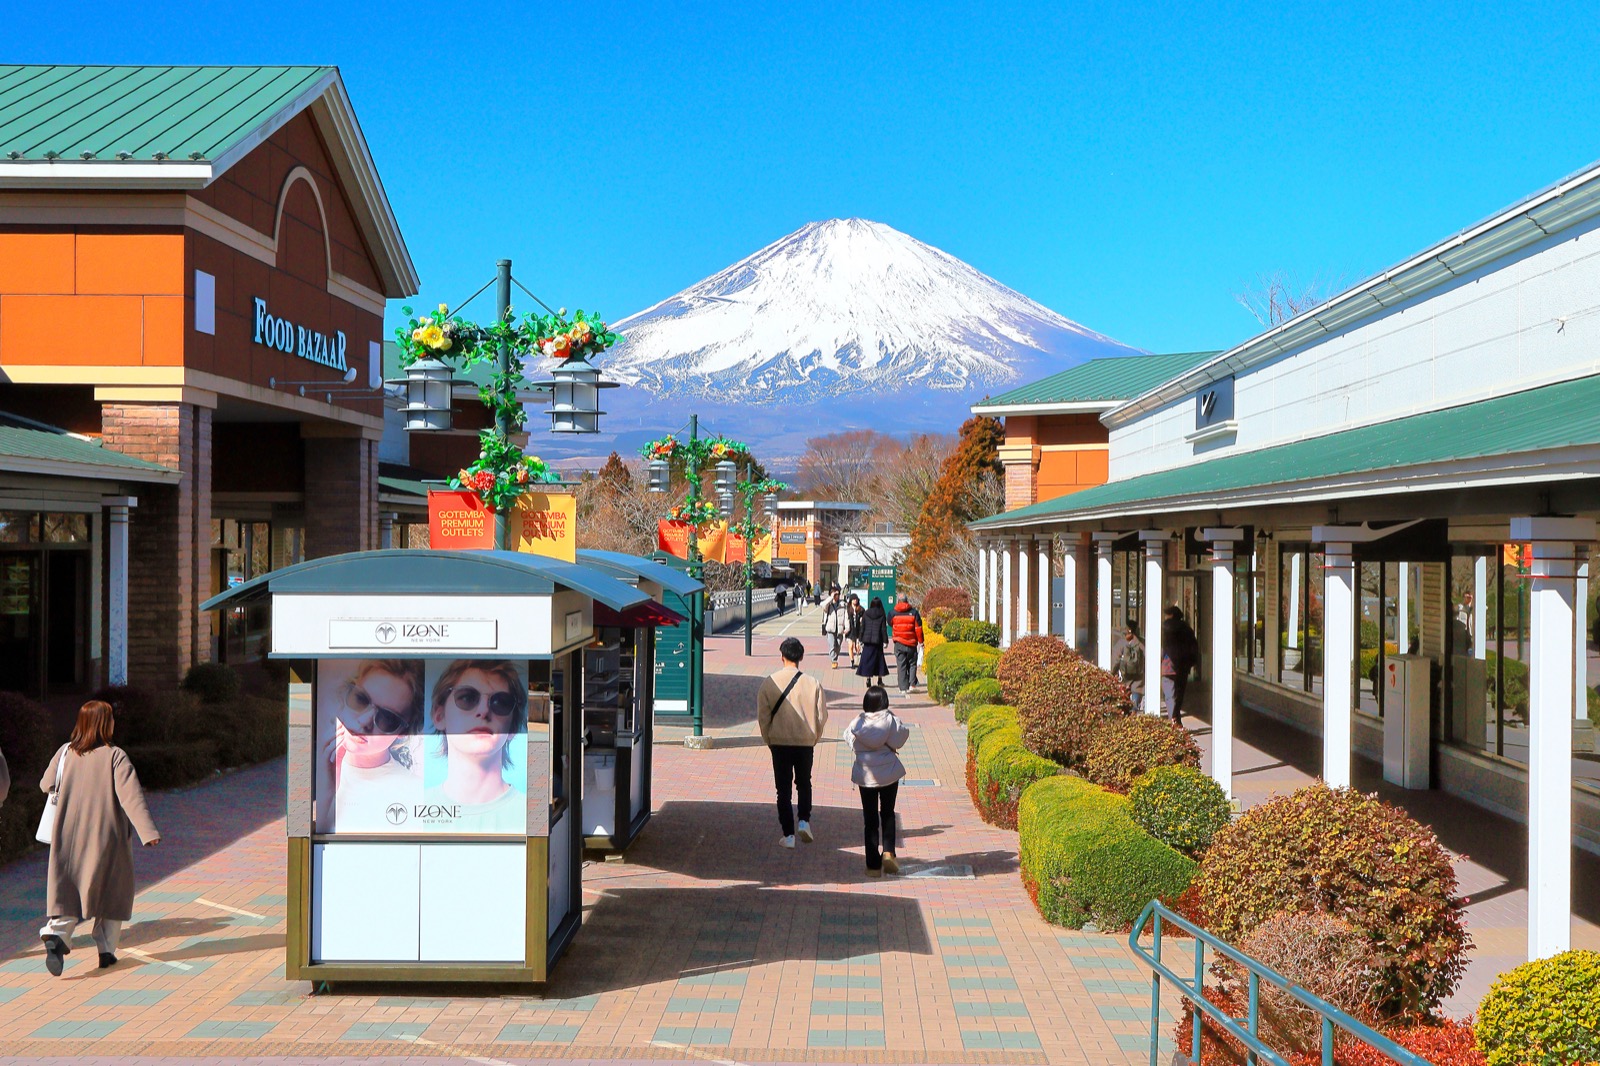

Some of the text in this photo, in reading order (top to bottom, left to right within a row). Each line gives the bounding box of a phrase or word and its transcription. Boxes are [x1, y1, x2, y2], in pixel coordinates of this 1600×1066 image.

[254, 296, 348, 372] FOOD BAZAAR
[438, 510, 486, 519] GOTEMBA
[520, 511, 567, 520] GOTEMBA
[441, 519, 484, 528] PREMIUM
[522, 520, 565, 529] PREMIUM
[442, 528, 483, 536] OUTLETS
[523, 529, 565, 538] OUTLETS
[403, 624, 449, 637] IZONE
[414, 805, 461, 818] IZONE
